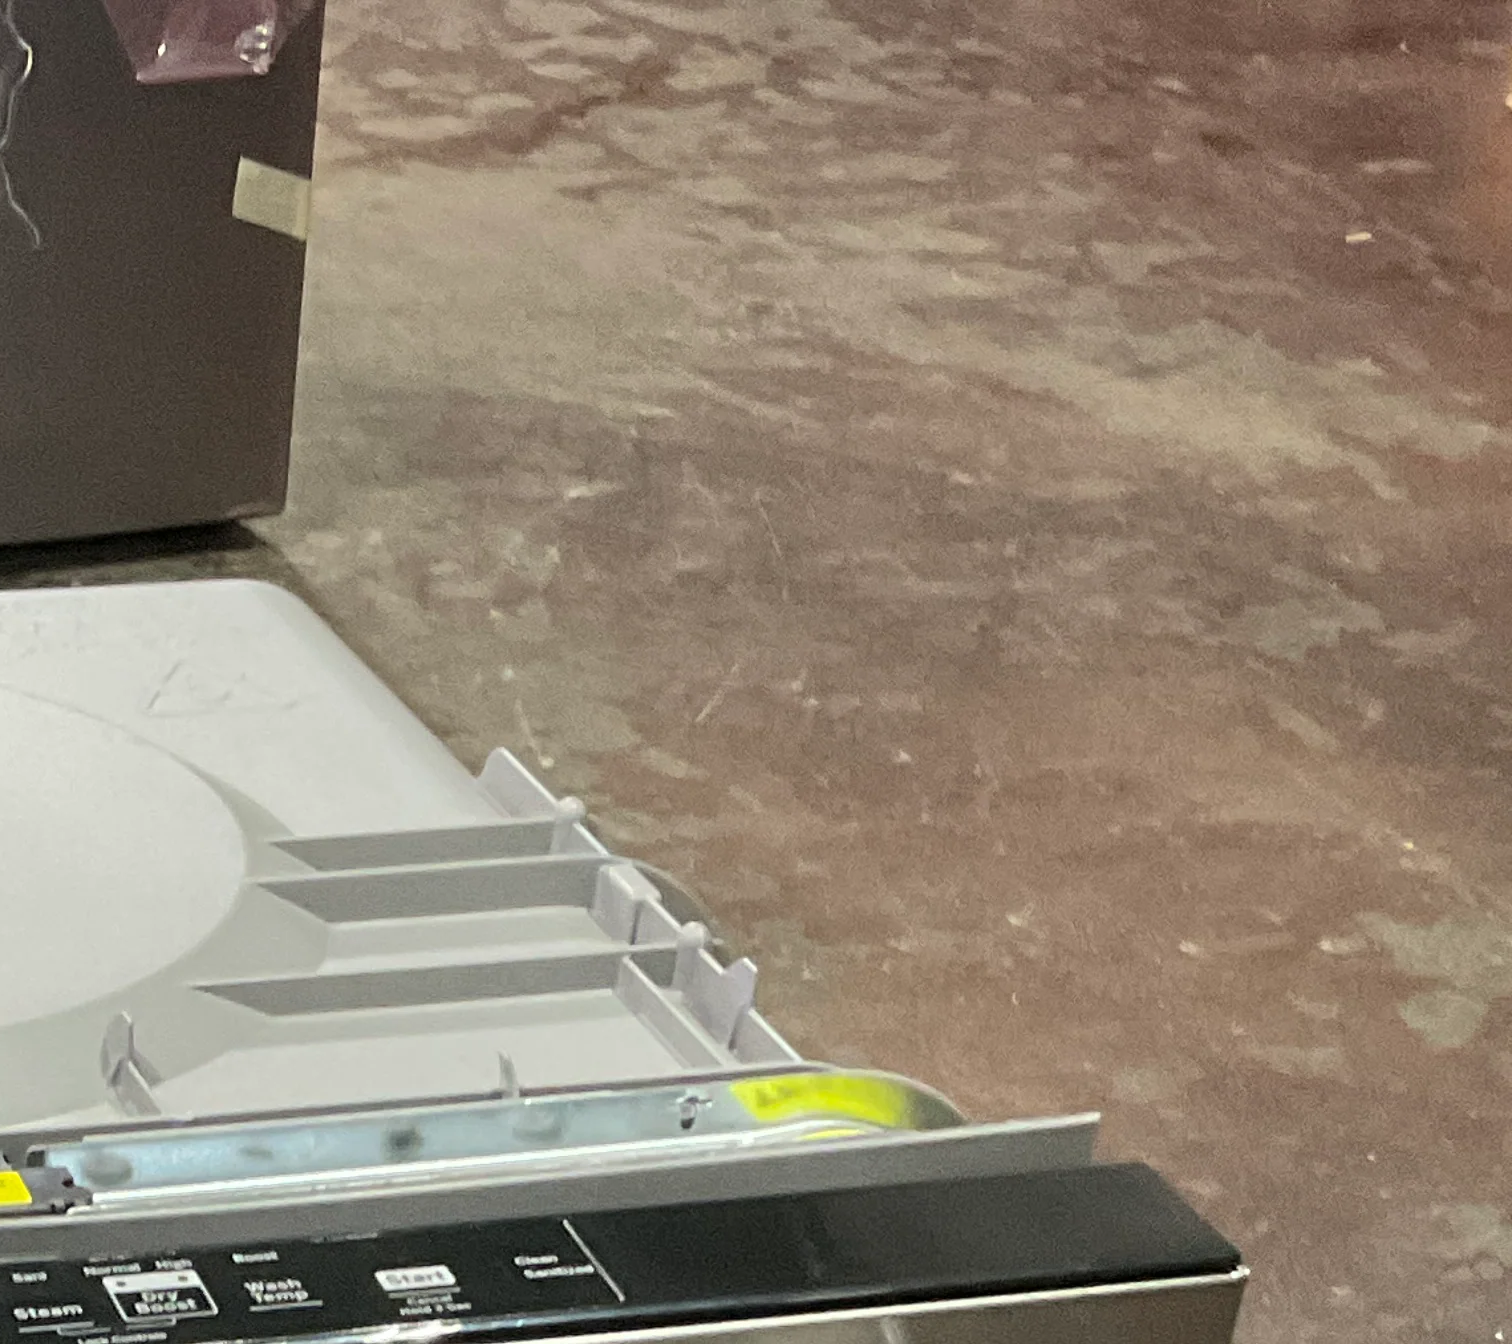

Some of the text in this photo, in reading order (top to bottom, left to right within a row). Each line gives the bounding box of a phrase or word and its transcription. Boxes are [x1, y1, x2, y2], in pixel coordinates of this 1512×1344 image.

[243, 1278, 302, 1293] Wash
[385, 1271, 445, 1286] Start
[141, 1290, 179, 1302] Dry
[250, 1289, 309, 1304] Temp
[13, 1304, 84, 1321] Steam
[134, 1298, 197, 1315] Boost
